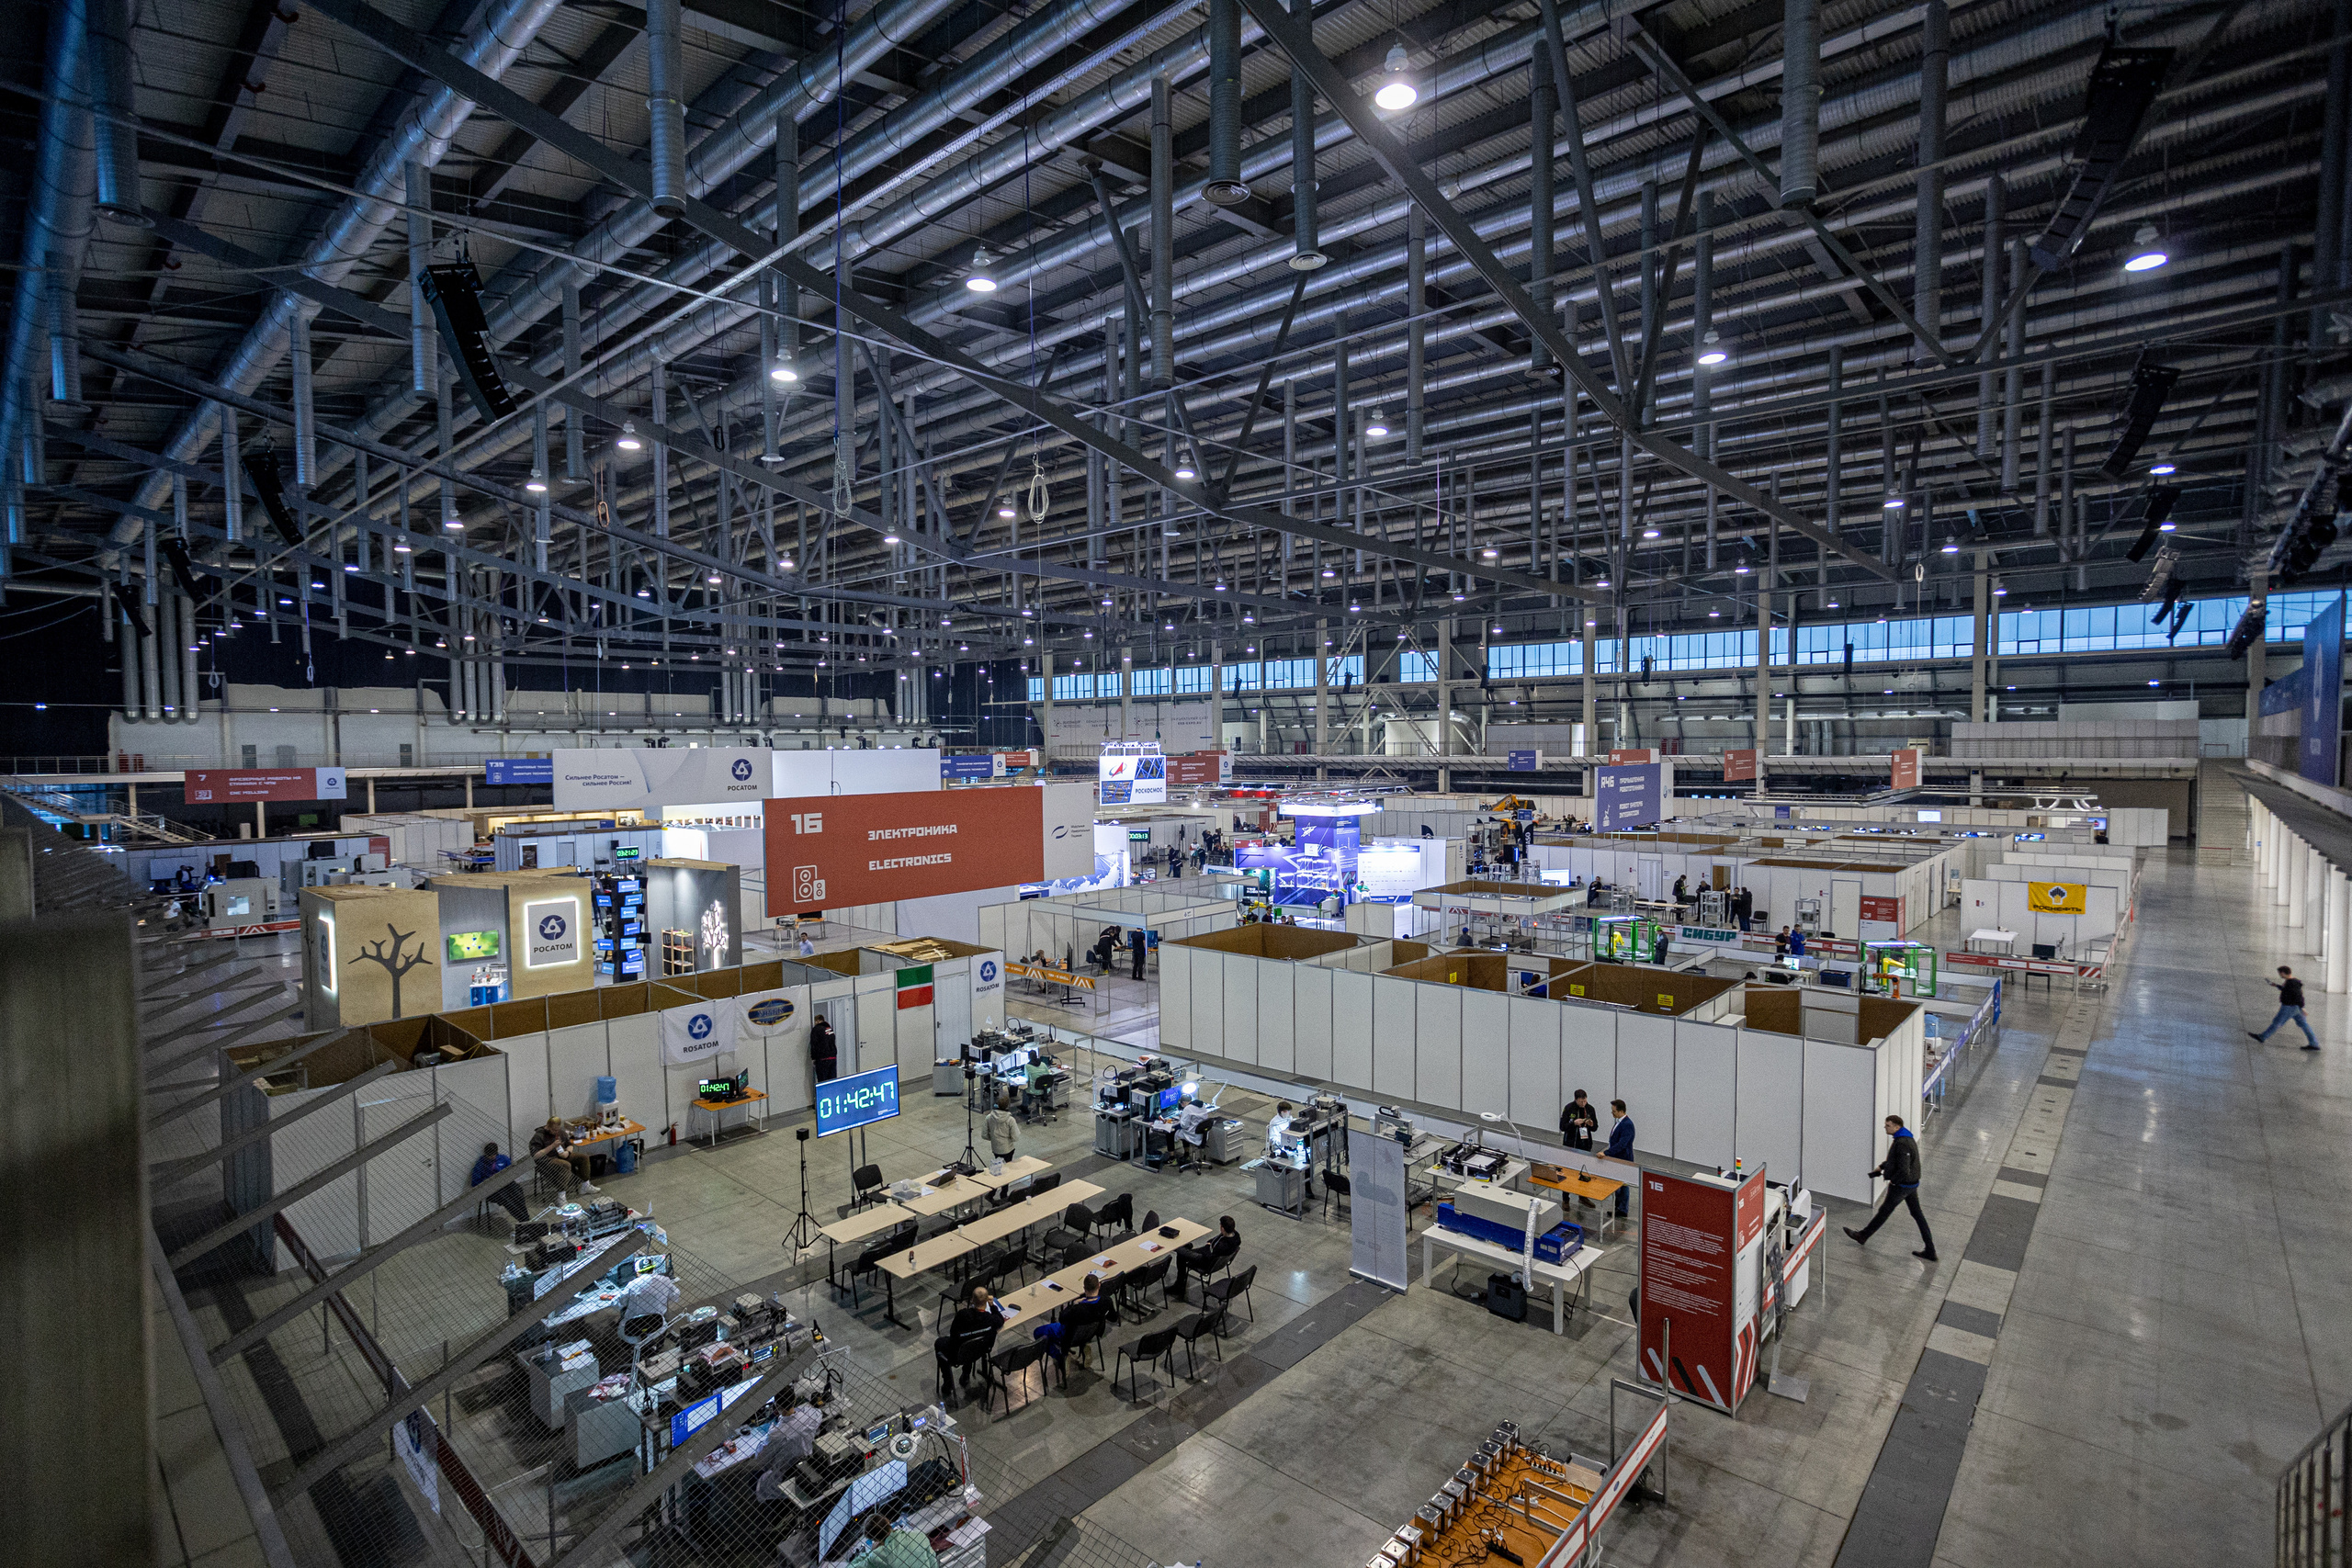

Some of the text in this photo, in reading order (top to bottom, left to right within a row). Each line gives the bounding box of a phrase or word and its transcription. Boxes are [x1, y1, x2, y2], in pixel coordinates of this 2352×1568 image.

[1601, 776, 1614, 788] R46
[790, 812, 823, 835] 16
[868, 824, 958, 841] ЭЛЕКТРОНИКА
[869, 853, 952, 871] ELECTRONICS
[1682, 927, 1737, 942] СИБУР
[534, 943, 573, 953] РОСАТОМ
[976, 983, 999, 993] ROSATOM
[683, 1040, 719, 1053] ROSATOM
[700, 1083, 729, 1093] 01:42:47
[820, 1081, 894, 1119] 01:42:47
[1649, 1181, 1664, 1192] 16
